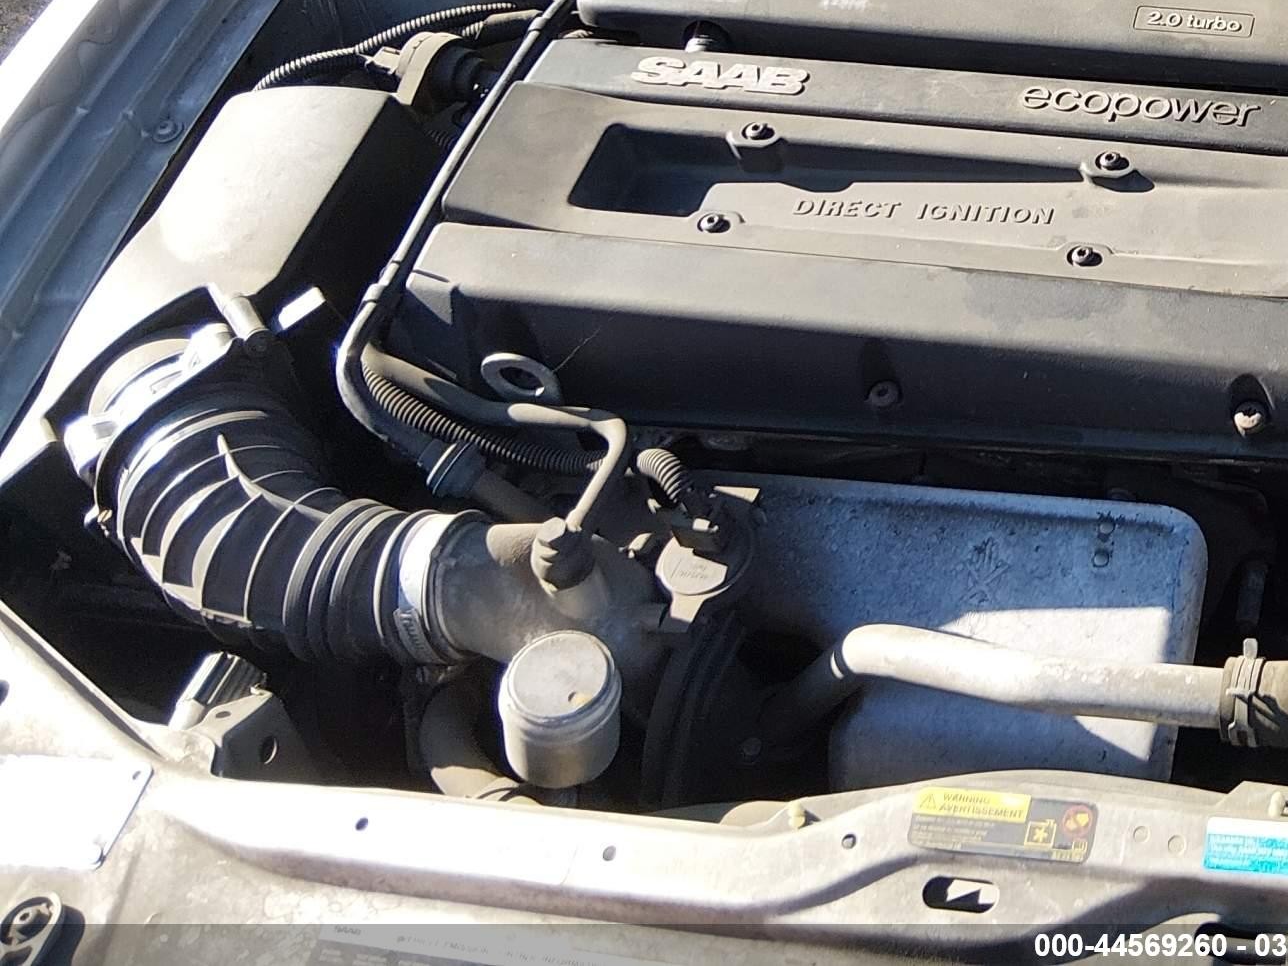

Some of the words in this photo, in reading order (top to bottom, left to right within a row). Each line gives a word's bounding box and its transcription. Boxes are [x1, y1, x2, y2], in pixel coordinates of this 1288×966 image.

[1147, 10, 1183, 29] 2.0
[1186, 13, 1243, 33] turbo
[631, 56, 810, 96] SAAB
[1020, 85, 1262, 128] ecopower
[793, 199, 902, 219] DIRECT
[916, 202, 1056, 225] IGNITION
[942, 792, 991, 805] WARNING
[939, 804, 1025, 820] AVERTISSEMENT
